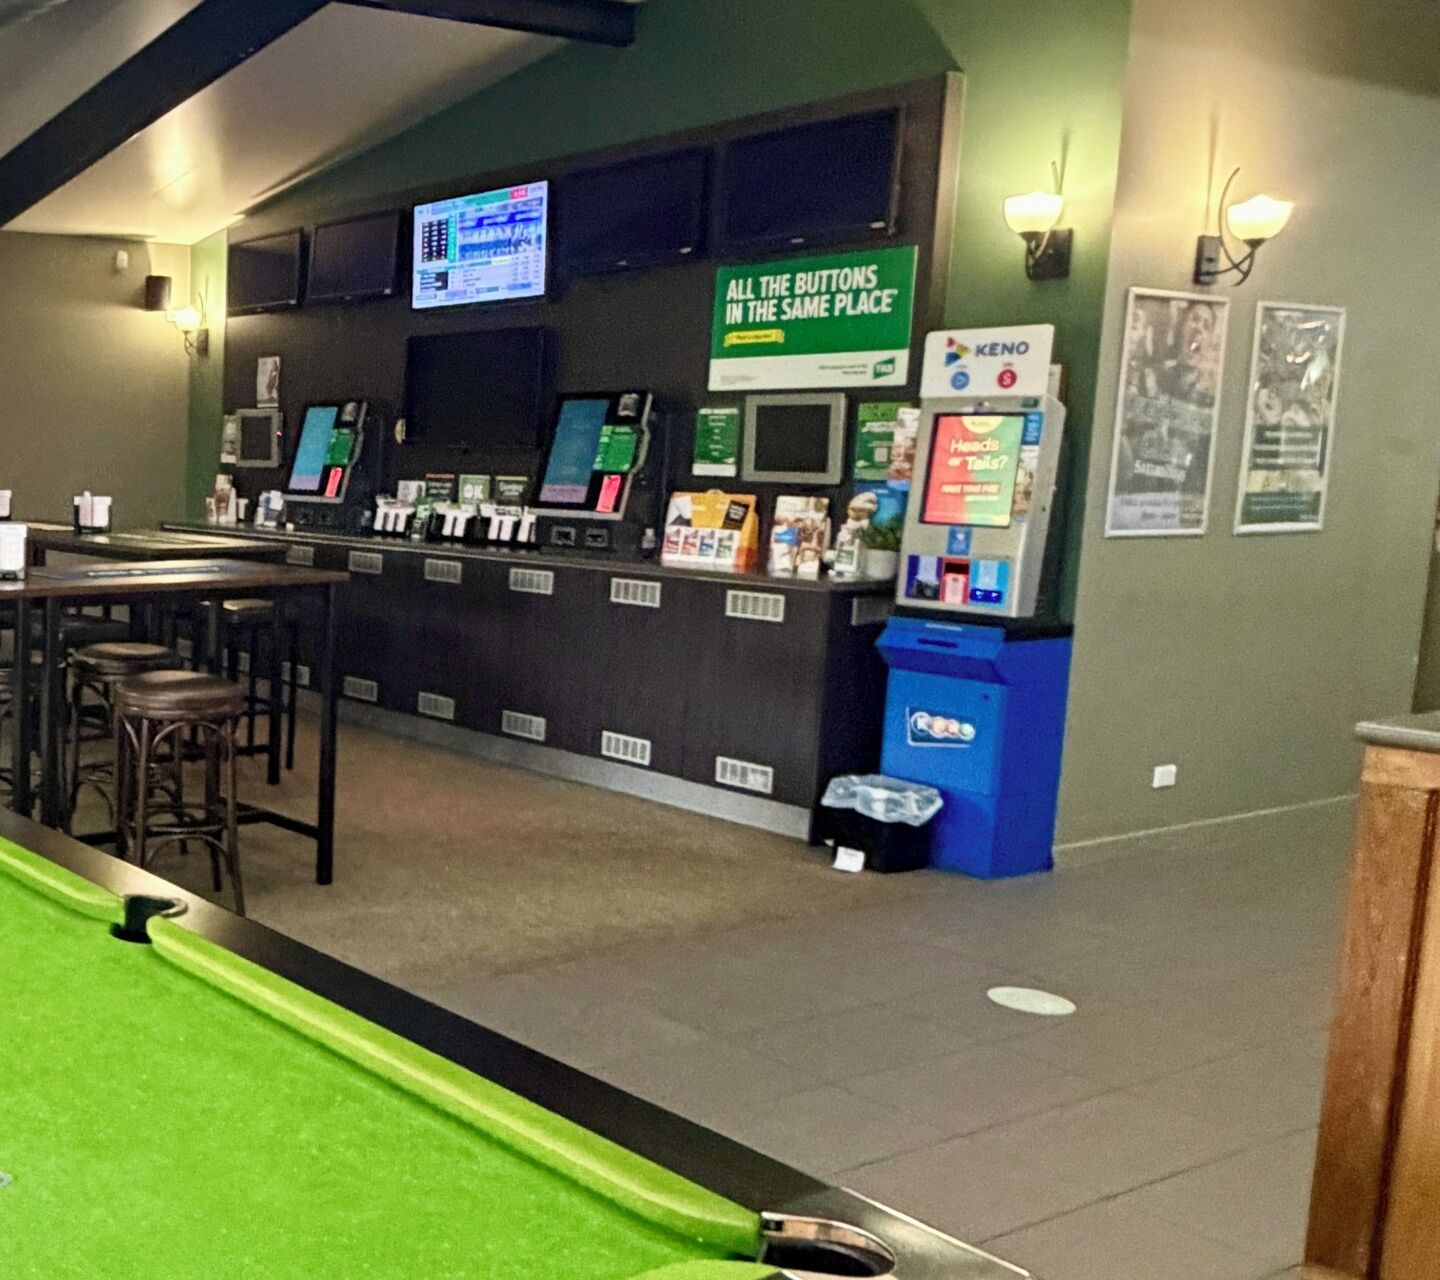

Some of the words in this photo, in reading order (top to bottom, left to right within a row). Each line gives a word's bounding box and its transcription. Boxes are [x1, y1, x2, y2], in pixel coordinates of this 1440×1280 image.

[726, 277, 755, 301] ALL
[759, 273, 791, 298] THE
[794, 264, 878, 295] BUTTONS
[726, 301, 743, 324] IN
[747, 298, 778, 323] THE
[780, 294, 830, 320] SAME
[975, 340, 1029, 357] KENO
[950, 437, 1000, 454] Heads
[964, 454, 1009, 471] Tails?
